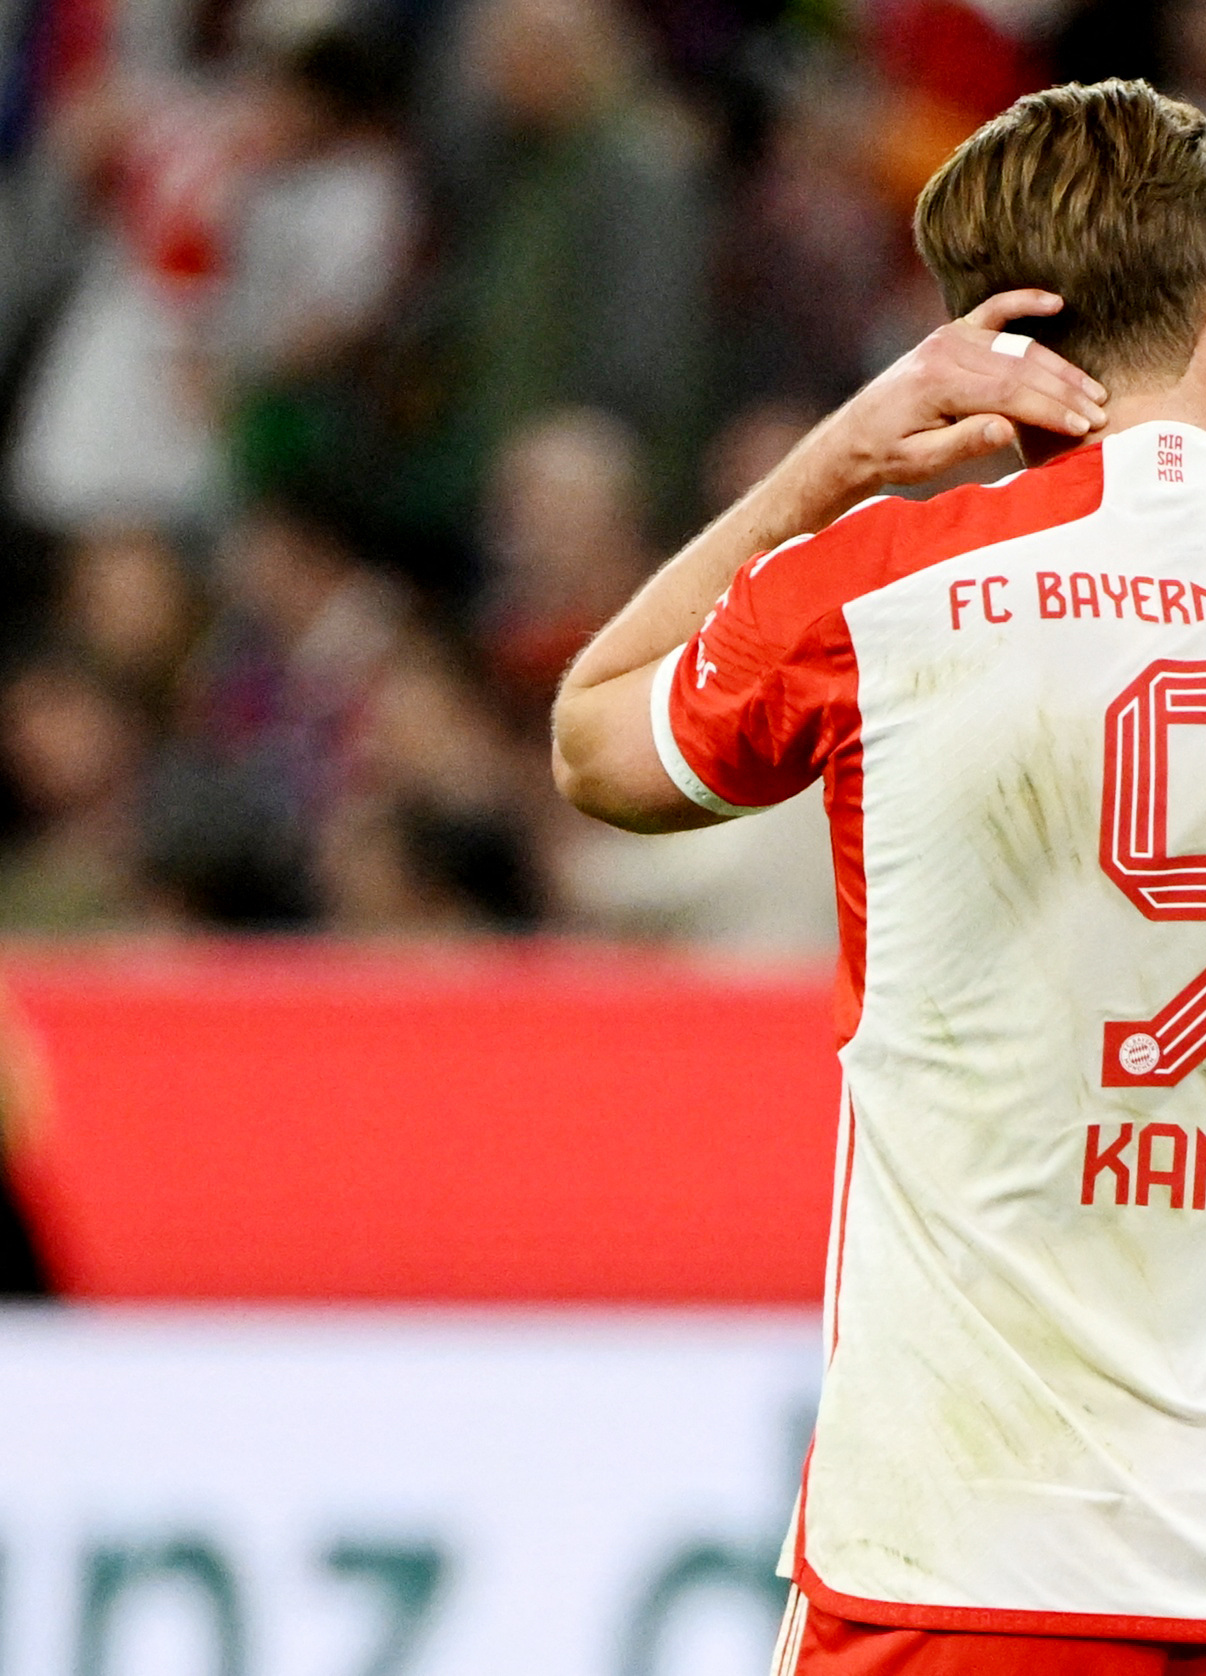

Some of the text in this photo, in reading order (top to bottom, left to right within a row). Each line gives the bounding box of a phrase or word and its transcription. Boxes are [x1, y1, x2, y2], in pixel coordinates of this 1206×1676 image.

[1158, 433, 1183, 450] MIA
[1157, 450, 1183, 467] SAN
[1157, 467, 1184, 483] MIA
[949, 575, 1012, 631] FC
